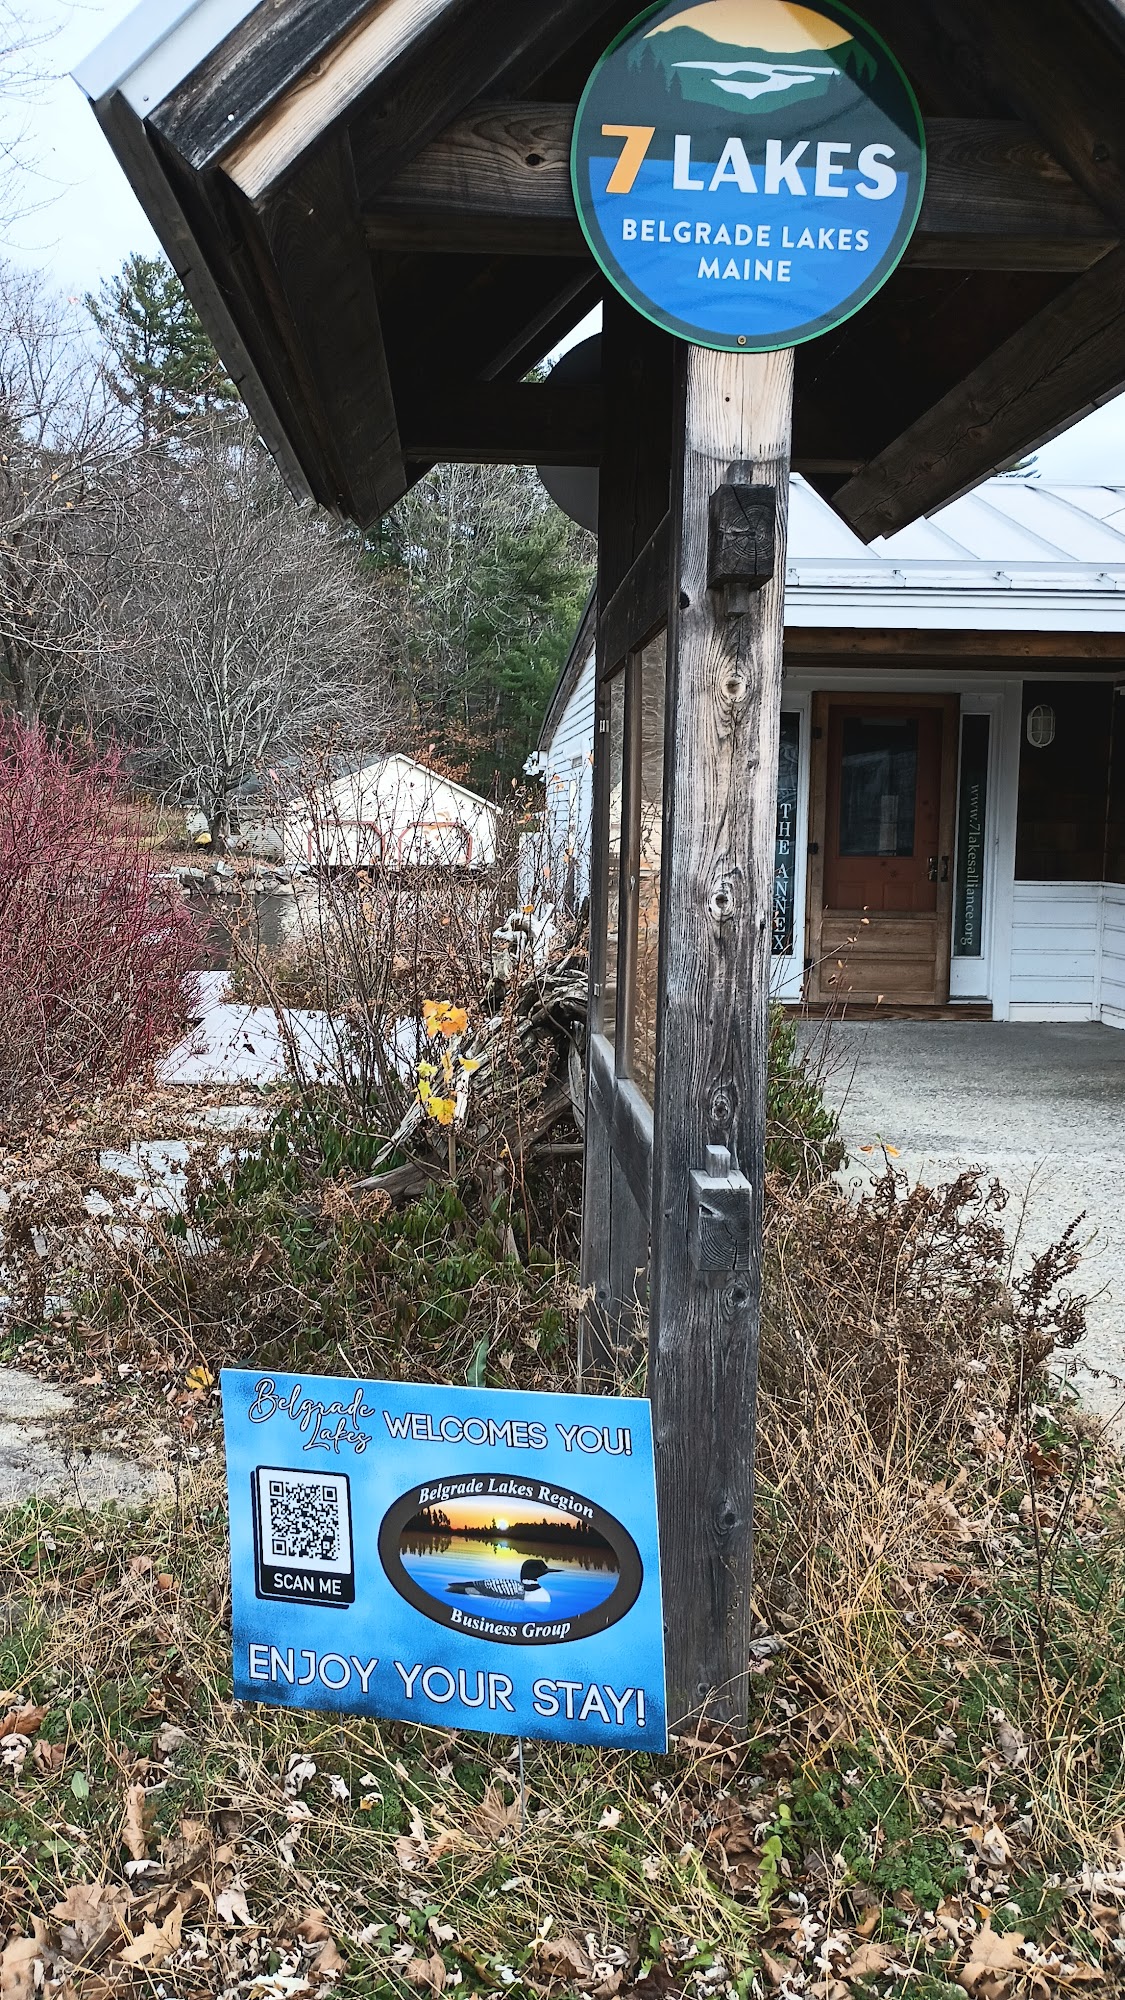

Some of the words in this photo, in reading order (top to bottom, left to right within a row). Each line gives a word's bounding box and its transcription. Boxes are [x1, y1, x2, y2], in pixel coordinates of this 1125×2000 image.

[602, 124, 656, 194] 7
[672, 134, 898, 200] LAKES
[621, 218, 772, 248] BELGRADE
[782, 226, 870, 252] LAKES
[697, 257, 792, 283] MAINE
[778, 803, 792, 855] THE
[960, 784, 981, 946] www.7lakesalliance.org
[773, 862, 789, 949] ANNEX
[248, 1377, 375, 1431] Belgrade
[303, 1412, 373, 1454] Lakes
[382, 1411, 548, 1450] WELCOMES
[556, 1423, 633, 1457] YOU!
[418, 1478, 484, 1505] Belgrade
[488, 1478, 534, 1498] Lakes
[538, 1485, 595, 1520] Region
[273, 1572, 316, 1593] SCAN
[319, 1576, 342, 1596] ME
[450, 1607, 518, 1637] Business
[522, 1622, 572, 1640] Group
[248, 1643, 378, 1693] ENJOY
[394, 1661, 516, 1712] YOUR
[533, 1678, 647, 1728] STAY!
